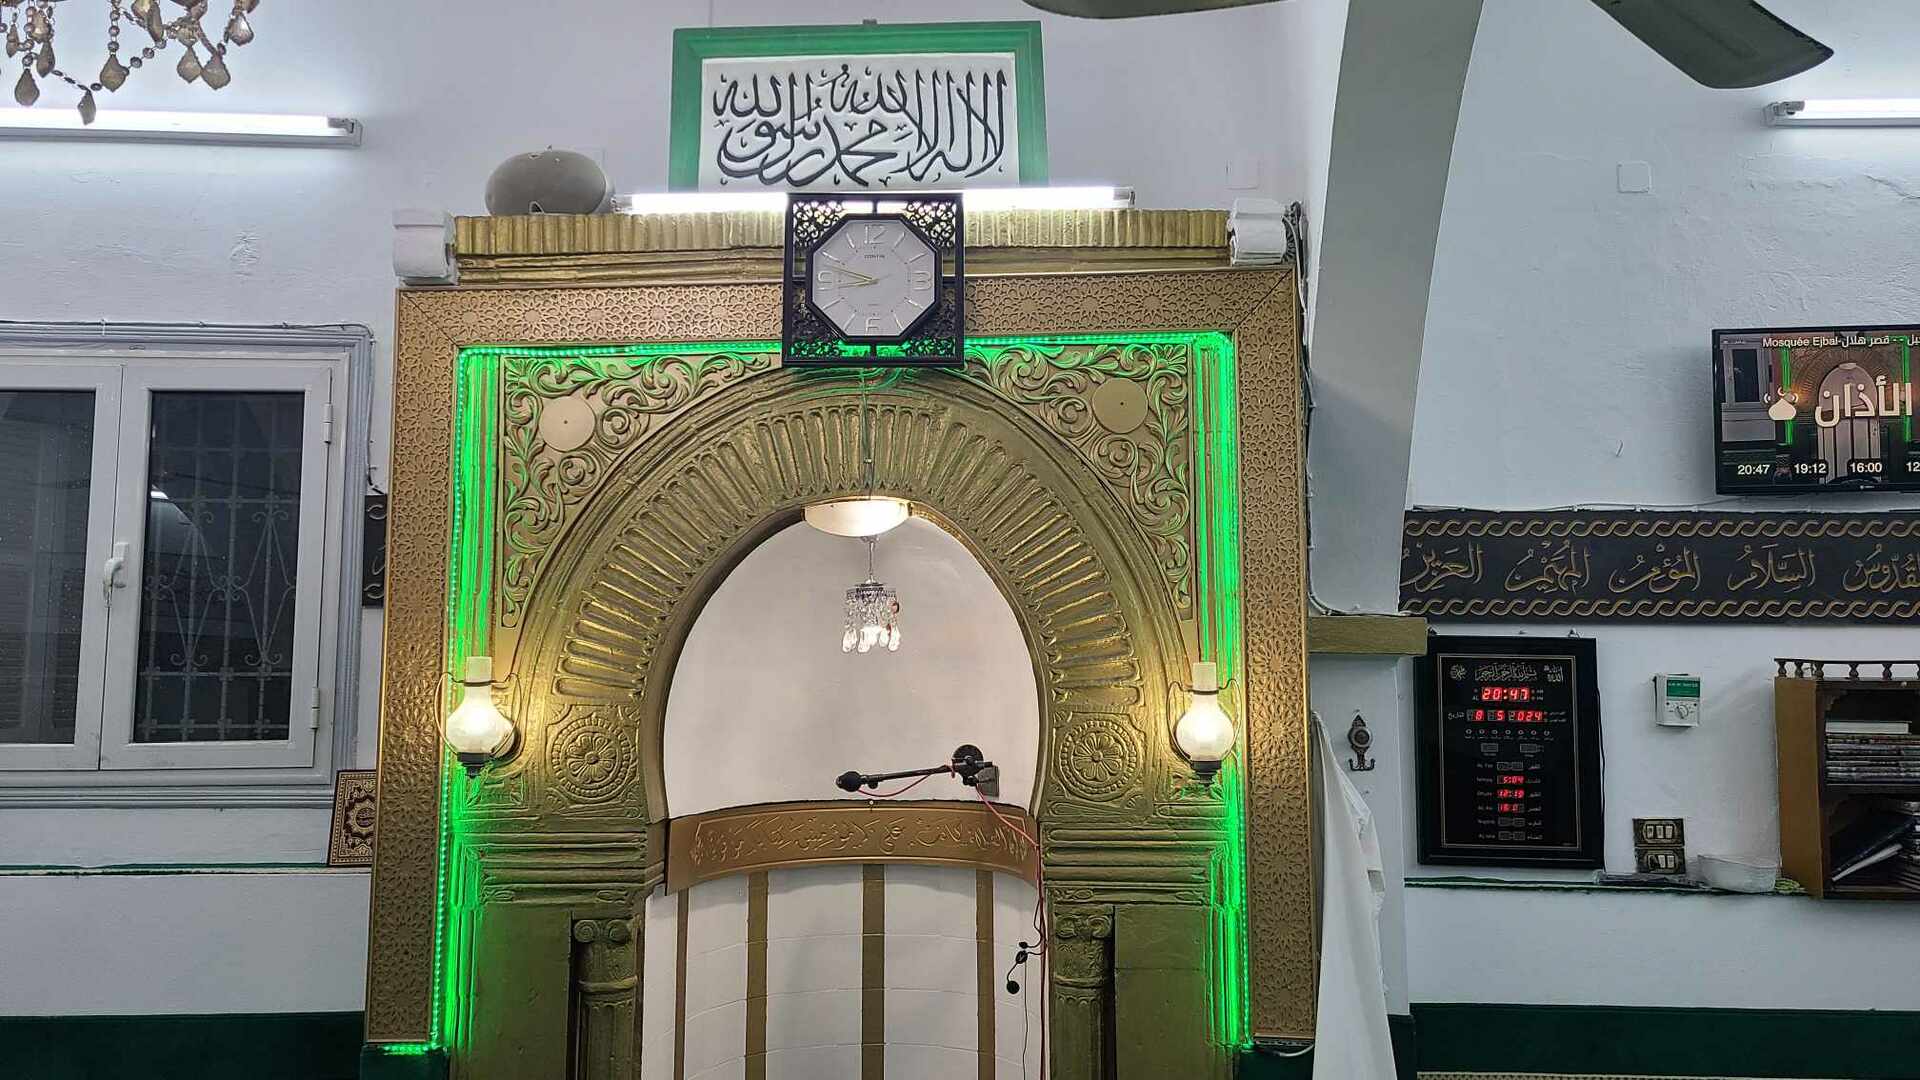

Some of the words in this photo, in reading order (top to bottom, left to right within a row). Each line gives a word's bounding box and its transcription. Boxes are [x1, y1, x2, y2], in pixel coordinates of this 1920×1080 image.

[1762, 336, 1809, 349] Mosquée
[1815, 375, 1912, 427] الأذان
[1737, 464, 1770, 475] 20:47
[1794, 463, 1827, 474] 19:12
[1850, 462, 1883, 472] 16:00
[1482, 688, 1529, 700] 20:47
